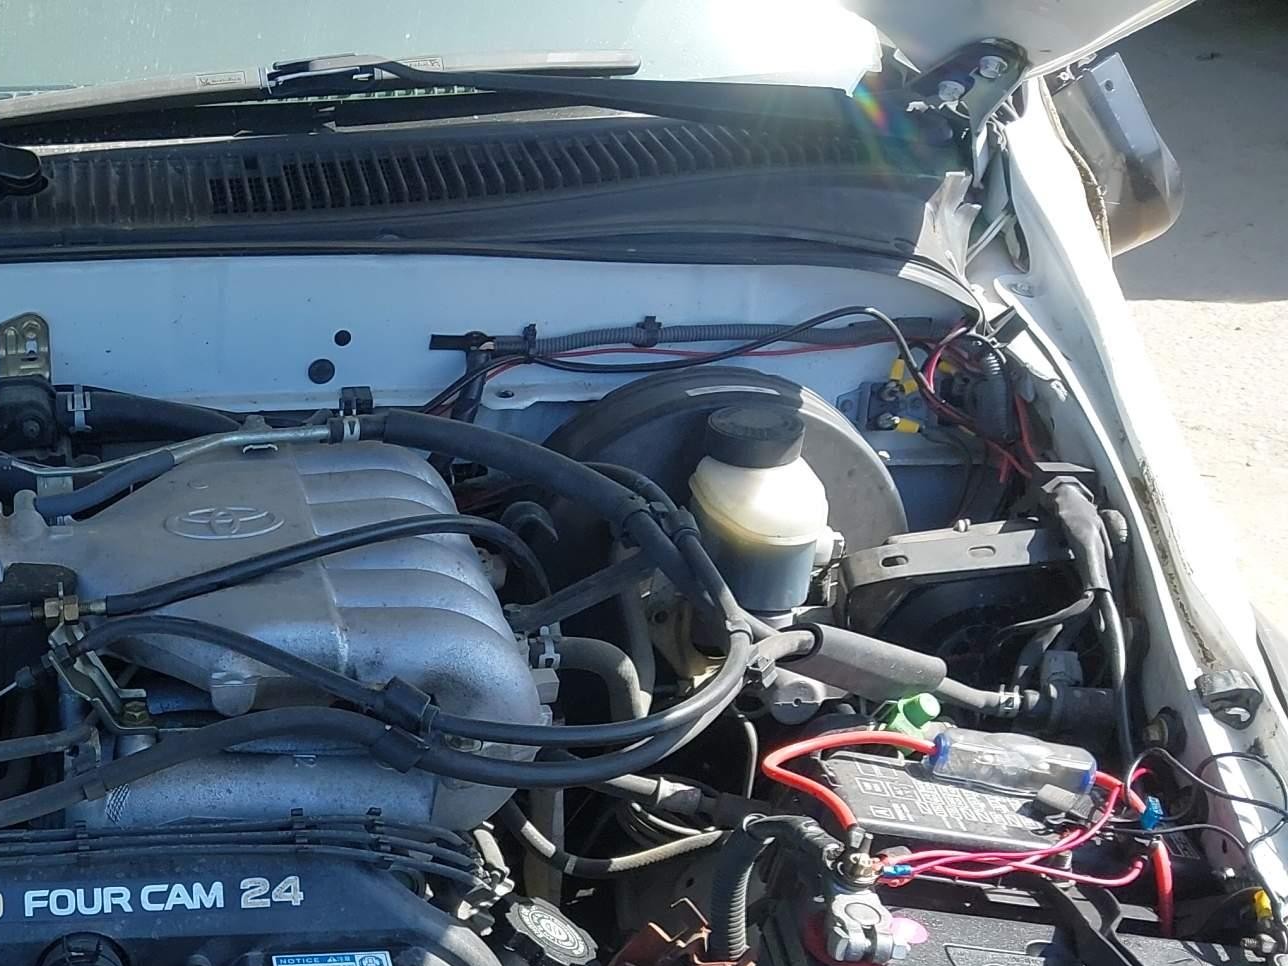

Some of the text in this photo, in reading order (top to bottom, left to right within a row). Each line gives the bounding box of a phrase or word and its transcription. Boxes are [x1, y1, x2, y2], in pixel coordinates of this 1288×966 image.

[24, 886, 133, 917] FOUR
[140, 881, 224, 911] CAM
[239, 875, 304, 909] 24
